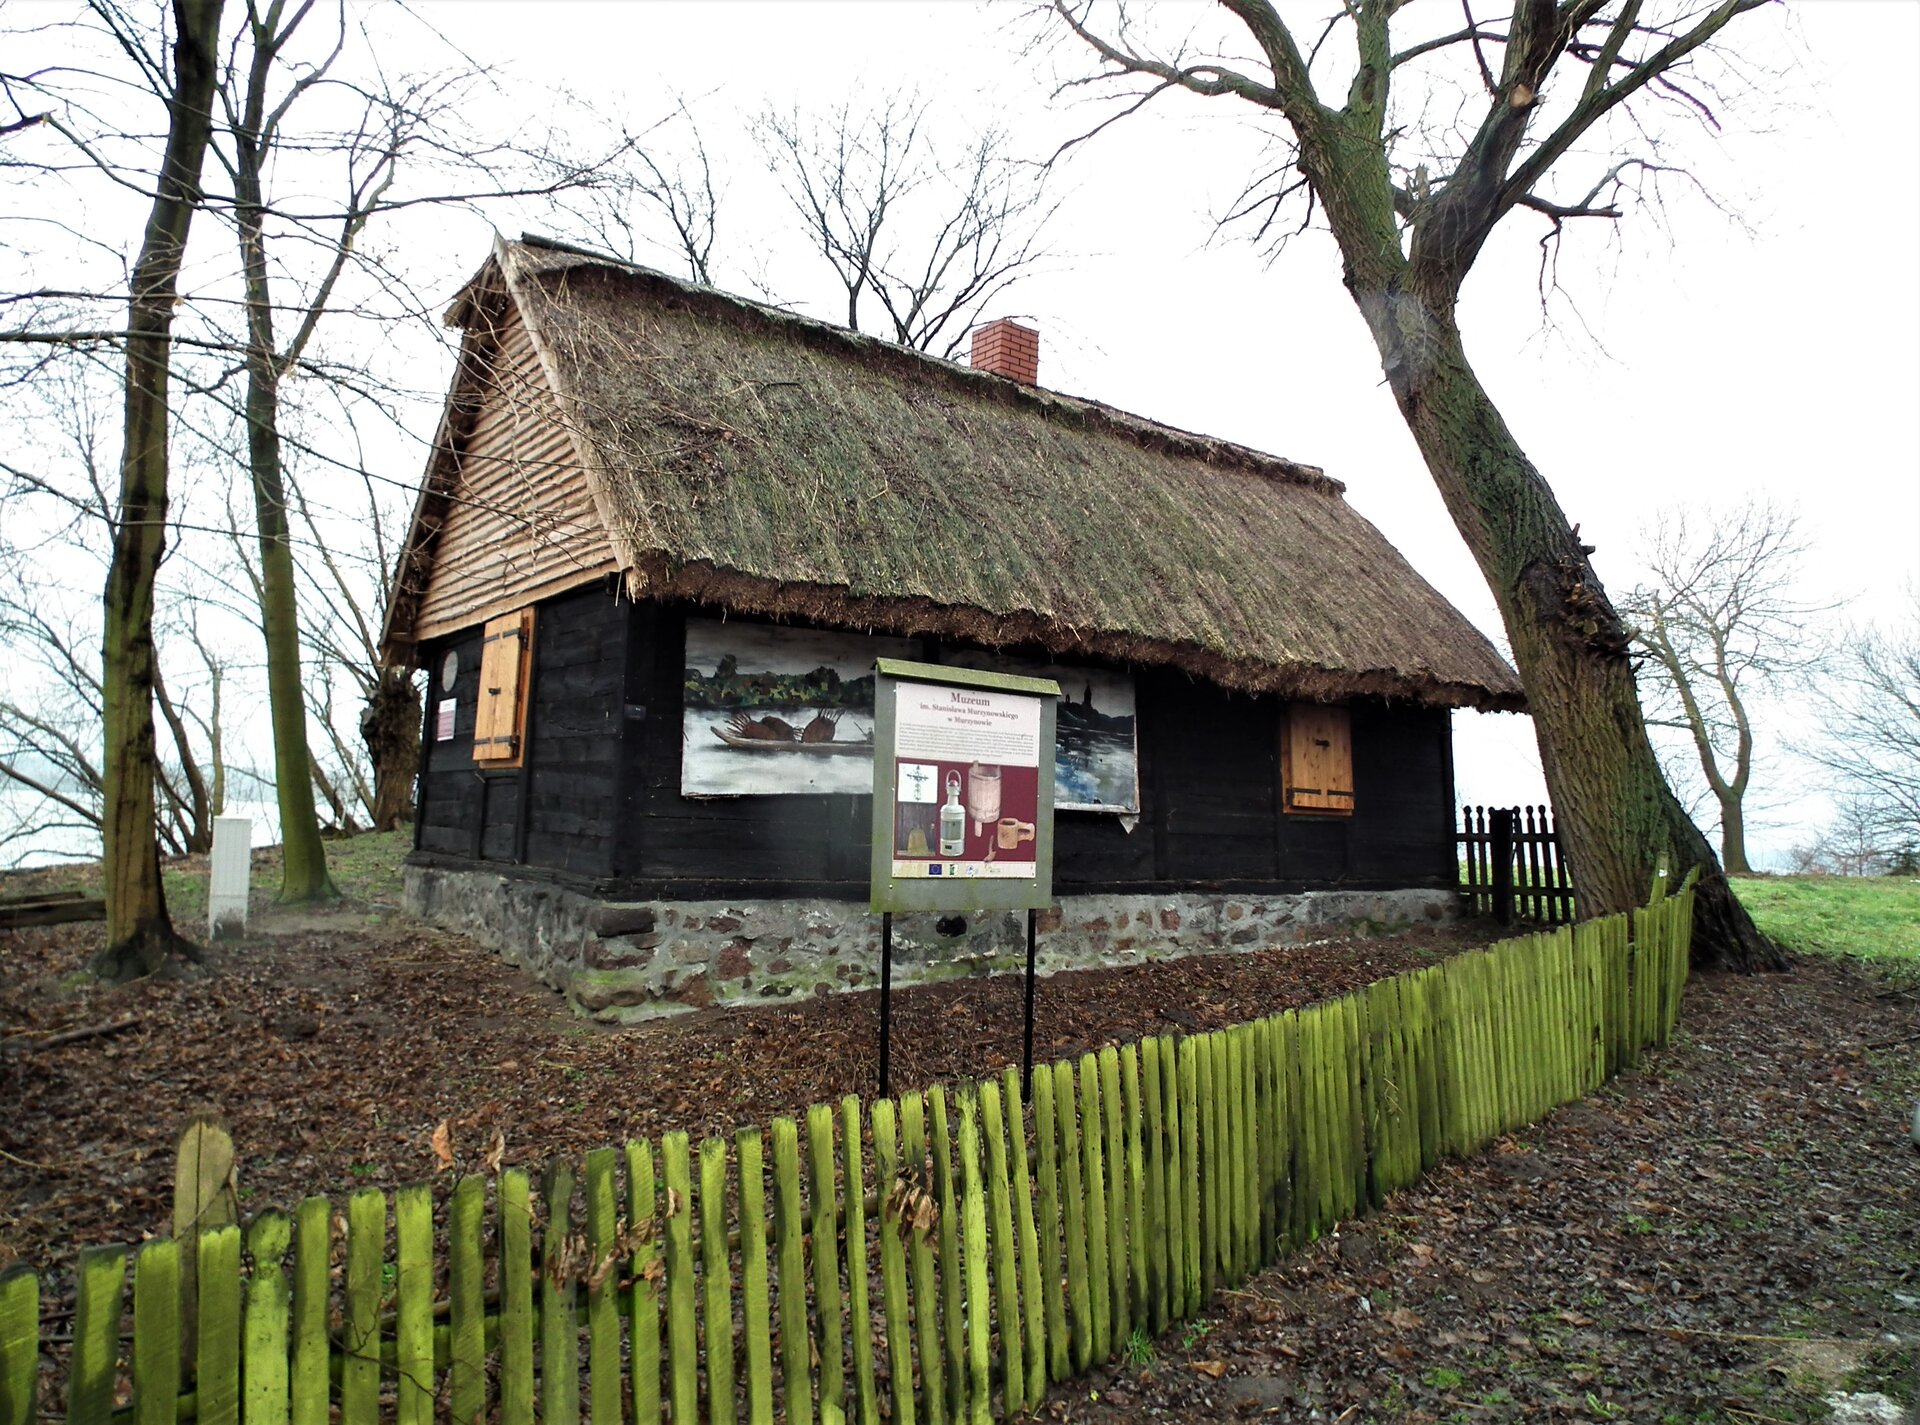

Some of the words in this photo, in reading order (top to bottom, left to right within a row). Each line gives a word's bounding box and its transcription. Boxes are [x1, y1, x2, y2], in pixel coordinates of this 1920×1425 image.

[951, 692, 990, 706] Muzeum
[932, 704, 966, 714] Stanisława
[967, 708, 1019, 720] Murzynowskiego
[954, 716, 993, 727] Murzynowie
